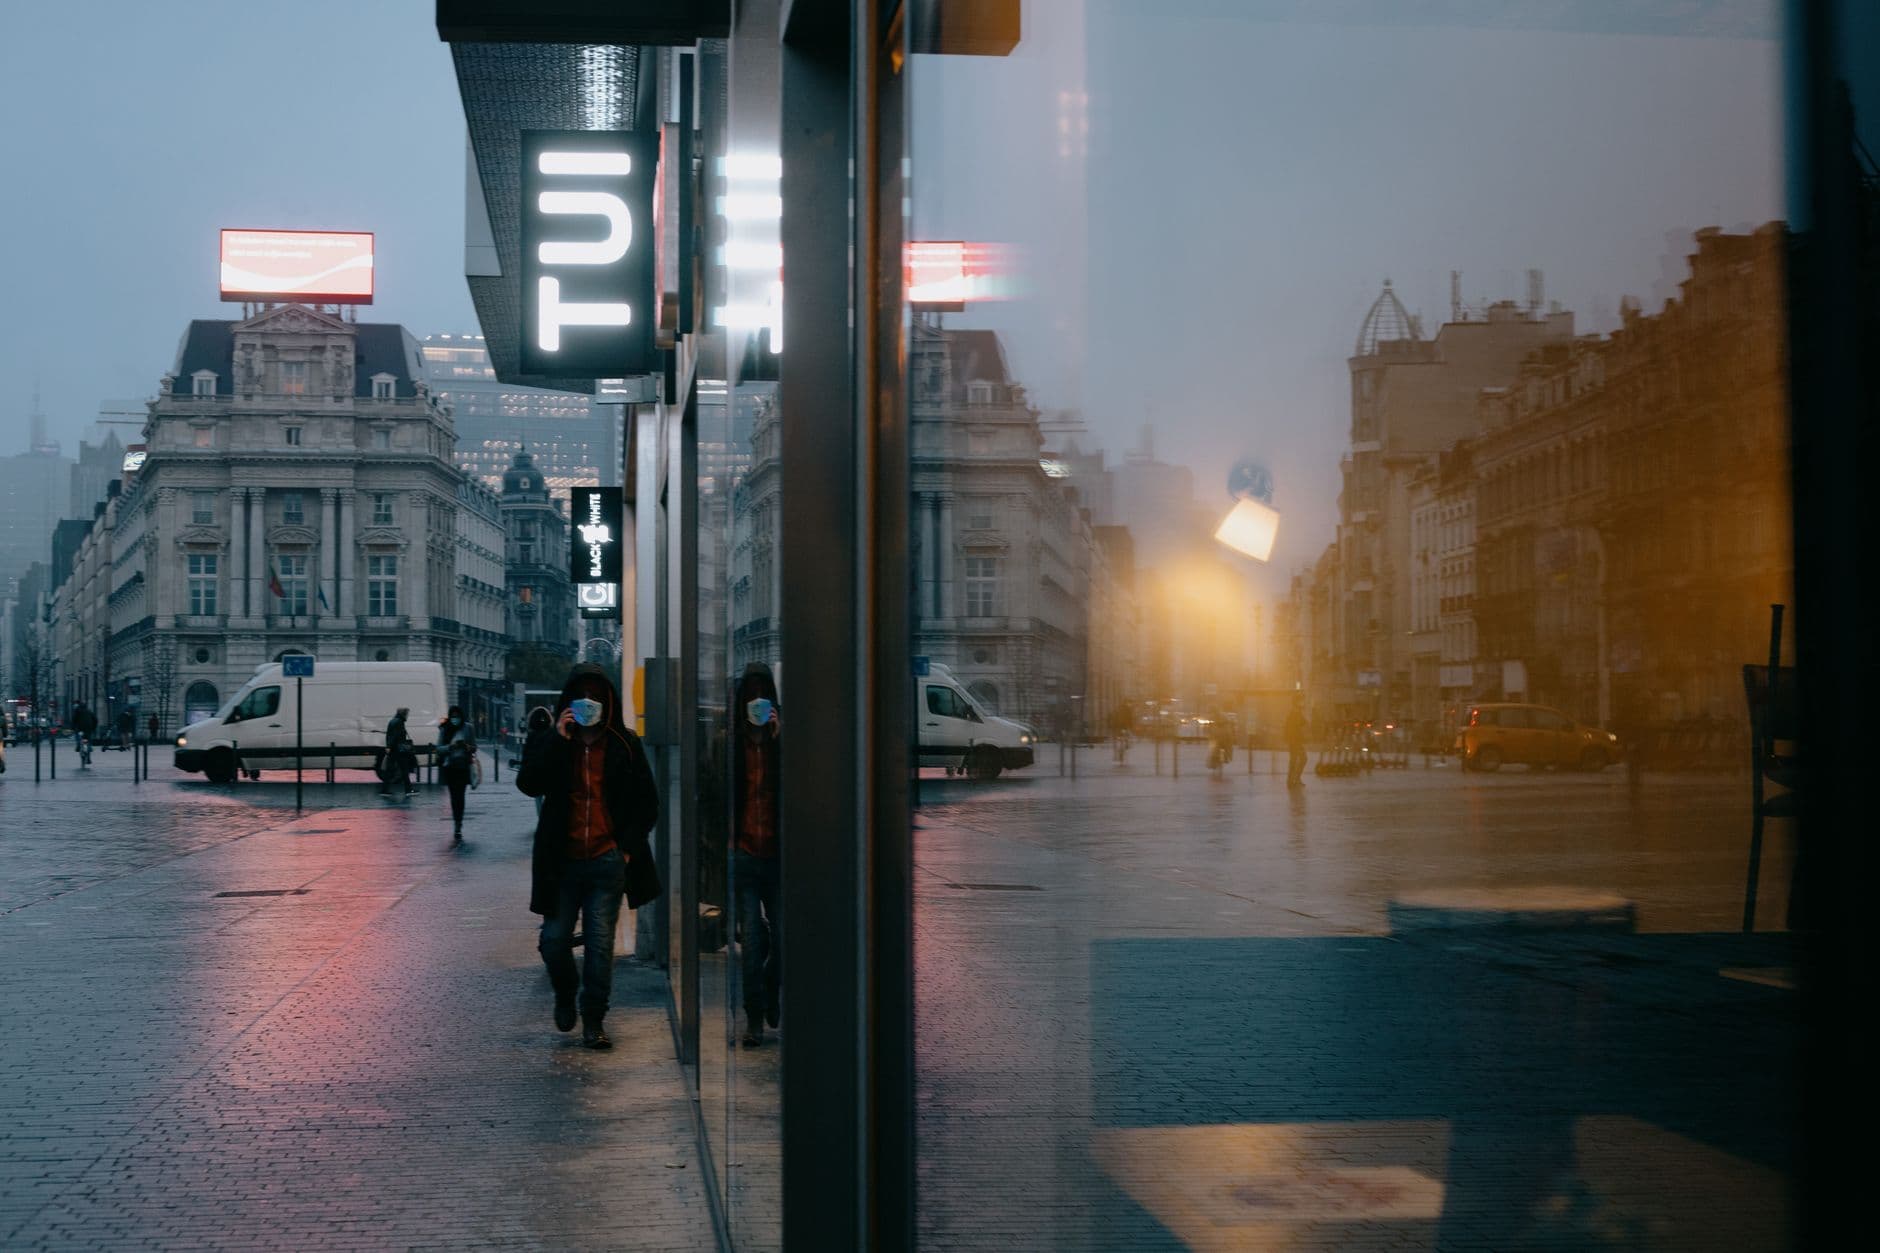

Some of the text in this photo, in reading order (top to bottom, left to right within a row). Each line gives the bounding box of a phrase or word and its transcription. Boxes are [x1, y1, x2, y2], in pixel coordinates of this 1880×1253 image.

[538, 151, 633, 351] TUI
[589, 493, 602, 577] BLACK WHITE
